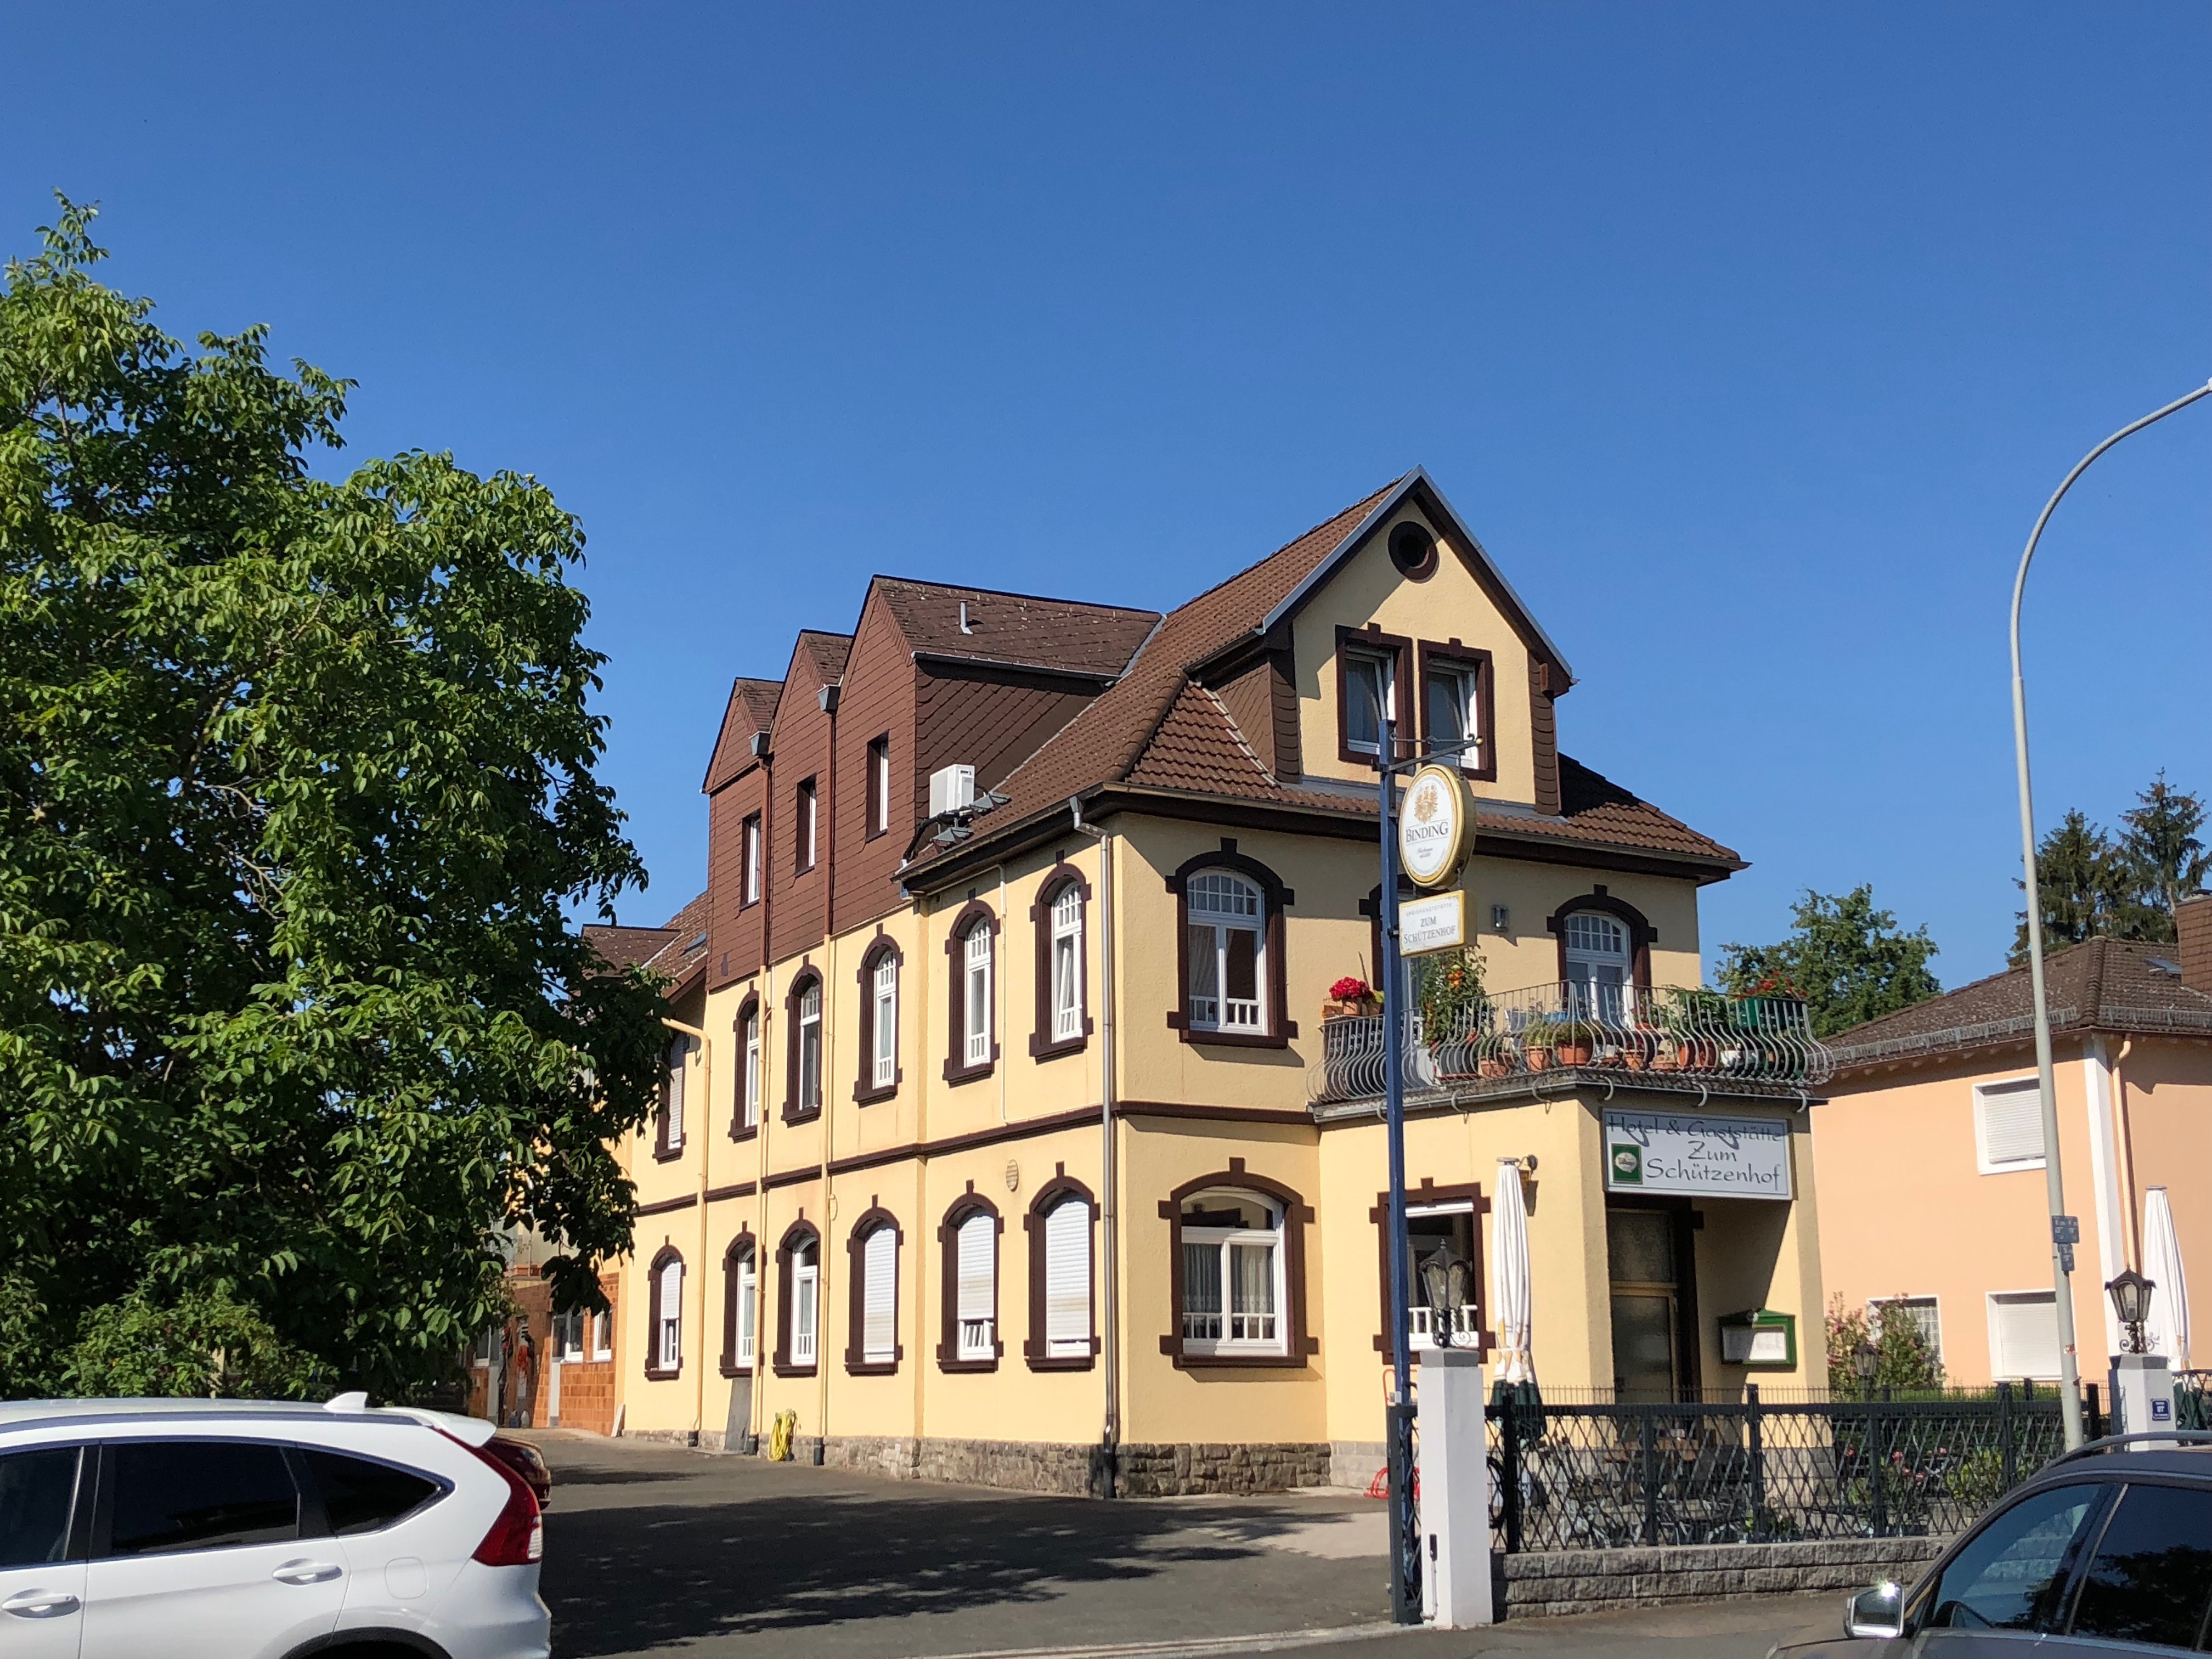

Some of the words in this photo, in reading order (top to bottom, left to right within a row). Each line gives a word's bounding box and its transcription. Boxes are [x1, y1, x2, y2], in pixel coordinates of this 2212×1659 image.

[1406, 821, 1448, 843] BINDING
[1420, 916, 1436, 927] ZUM
[1404, 925, 1455, 944] SCHÜTZENHOF
[1607, 1115, 1658, 1147] Hotel
[1666, 1119, 1681, 1136] &
[1687, 1121, 1782, 1150] Gaststätte
[1688, 1140, 1737, 1162] Zum
[1646, 1158, 1781, 1190] Schützenhof
